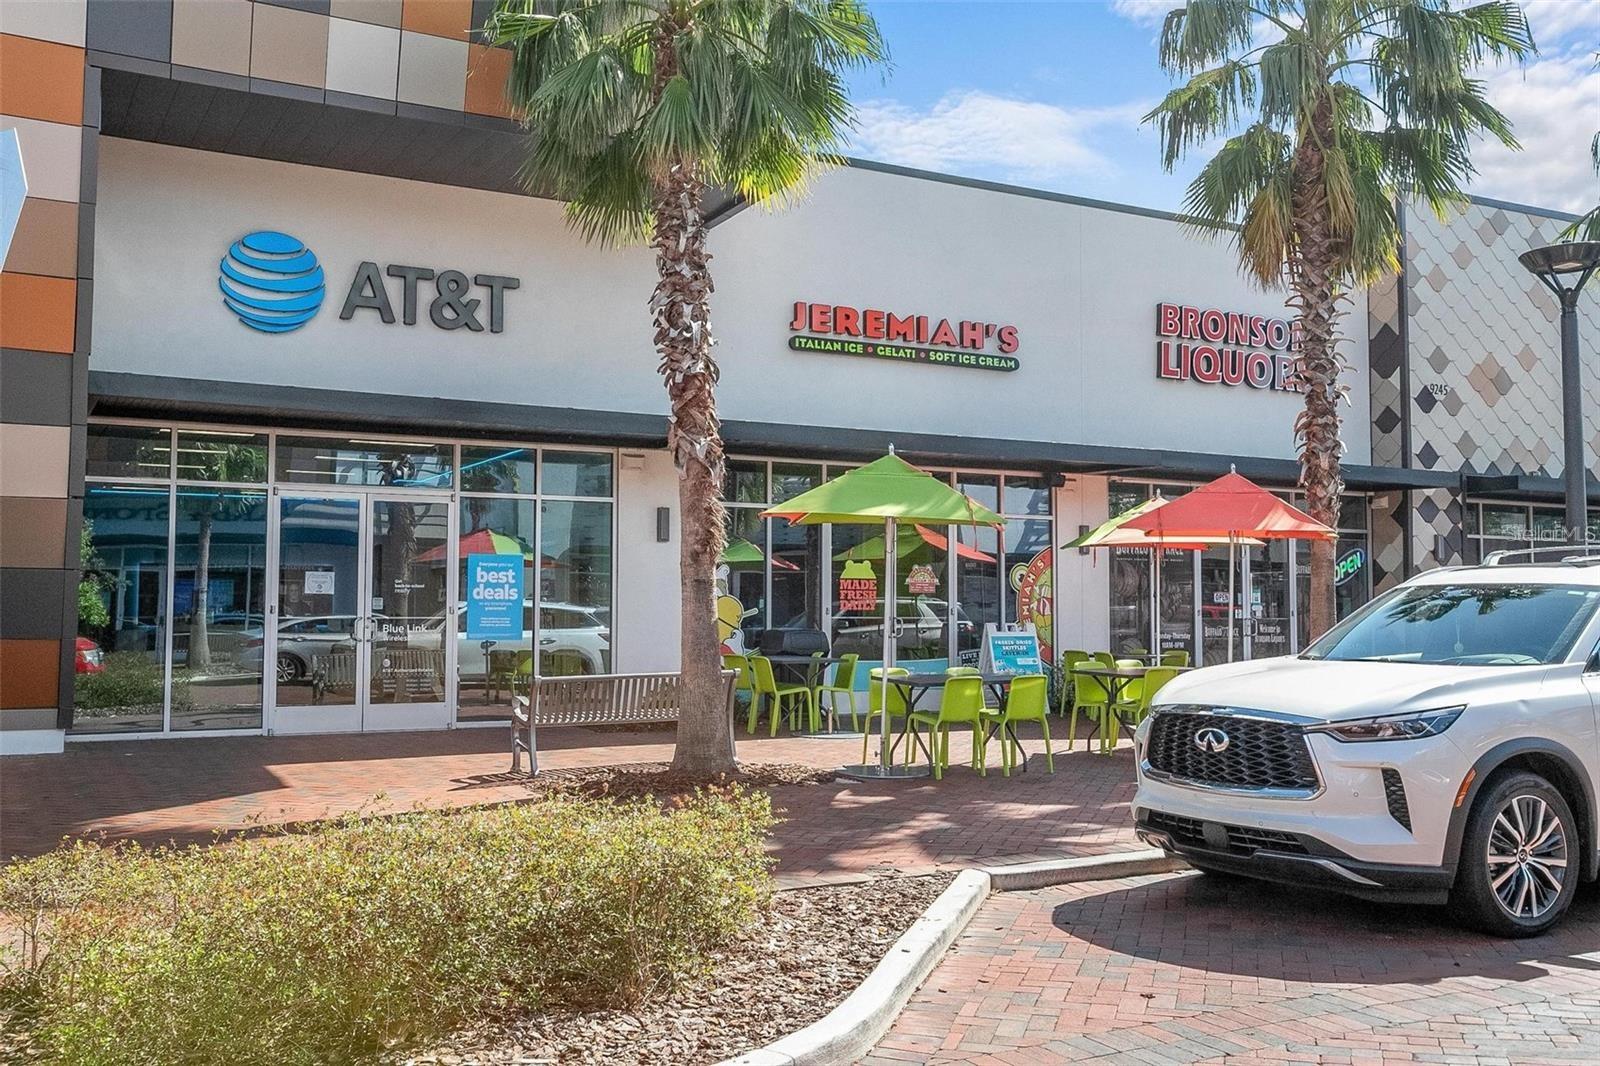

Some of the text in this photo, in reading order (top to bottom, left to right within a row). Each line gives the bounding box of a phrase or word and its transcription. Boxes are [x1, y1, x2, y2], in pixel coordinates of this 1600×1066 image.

[339, 261, 520, 333] AT&T
[790, 302, 1019, 353] JEREMIAH'S
[795, 338, 1015, 369] ITALIAN ICE GELATI SOFT ICE CREAM
[1430, 383, 1448, 396] 9245
[476, 567, 516, 583] best
[472, 583, 519, 600] deals
[840, 580, 877, 590] MADE
[840, 590, 877, 600] FRESH
[840, 600, 876, 611] DAILY
[382, 623, 428, 633] Blue Link
